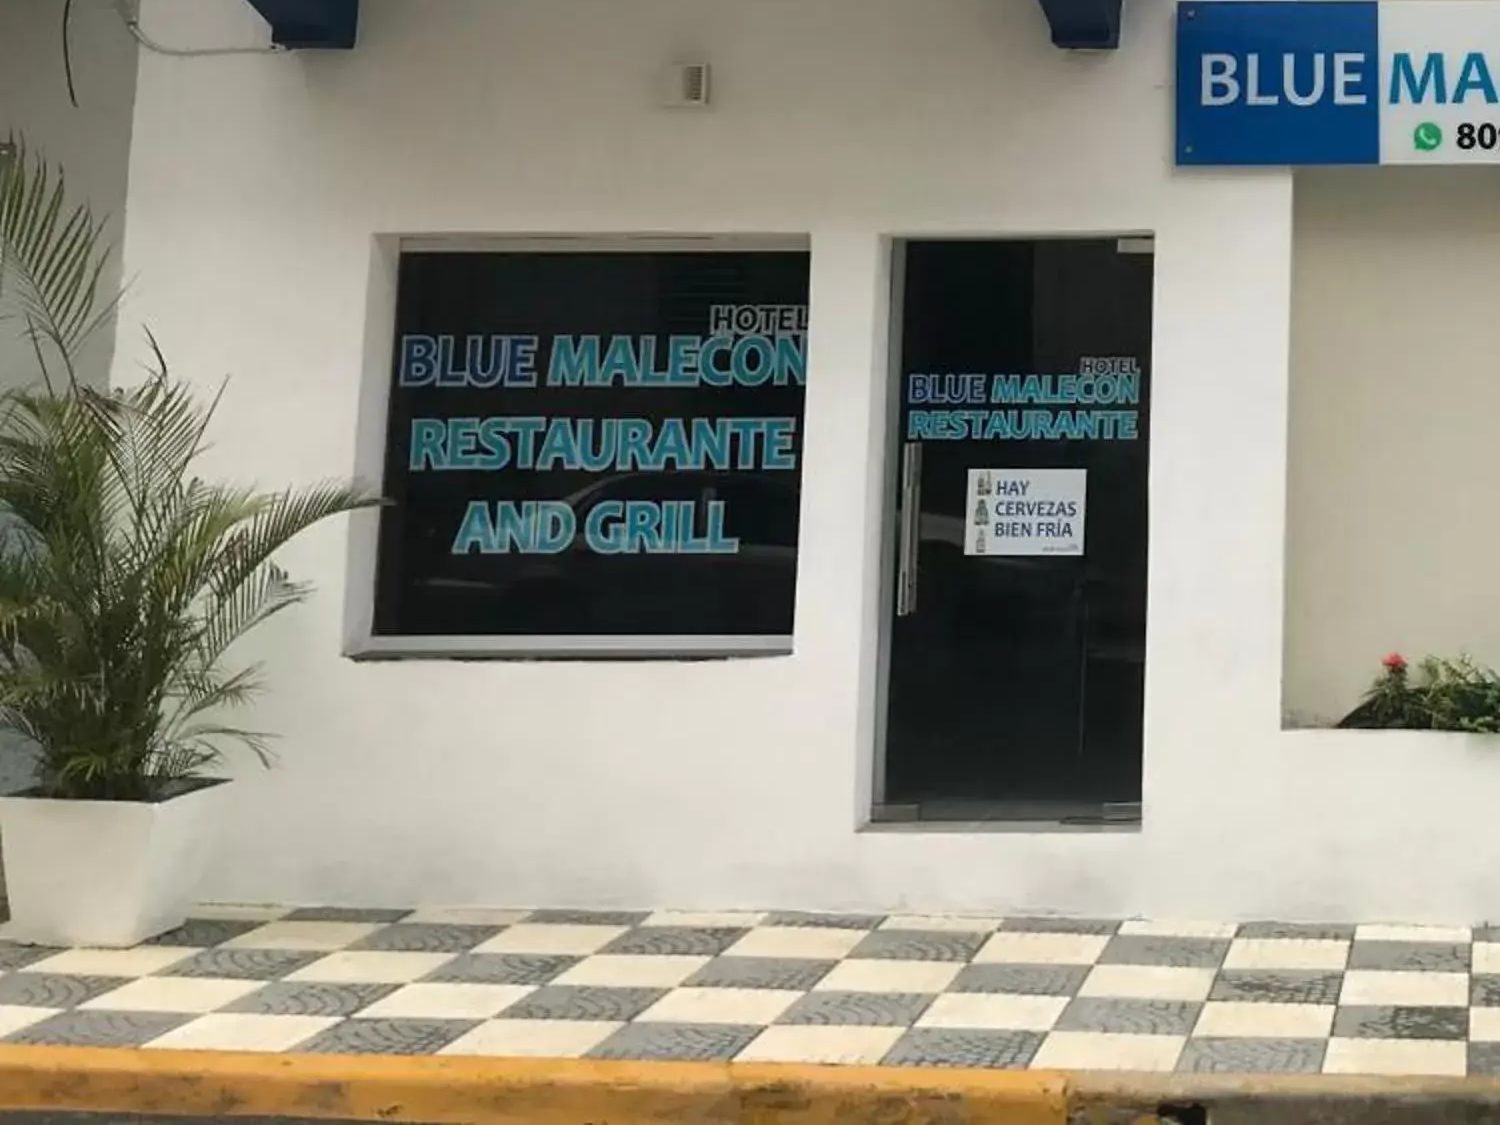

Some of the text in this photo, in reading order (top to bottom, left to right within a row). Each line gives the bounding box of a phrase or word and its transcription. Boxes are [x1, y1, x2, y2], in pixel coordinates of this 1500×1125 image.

[1200, 52, 1368, 106] BLUE
[709, 304, 808, 335] HOTEL
[400, 334, 808, 388] BLUE MALECON
[1080, 356, 1141, 375] HOTEL
[907, 373, 1141, 404] BLUE MALECON
[906, 409, 1139, 440] RESTAURANTE
[409, 416, 796, 472] RESTAURANTE
[995, 479, 1030, 496] HAY
[994, 500, 1077, 518] CERVEZAS
[451, 500, 740, 555] AND GRILL
[994, 520, 1074, 538] BIEN FRÍA
